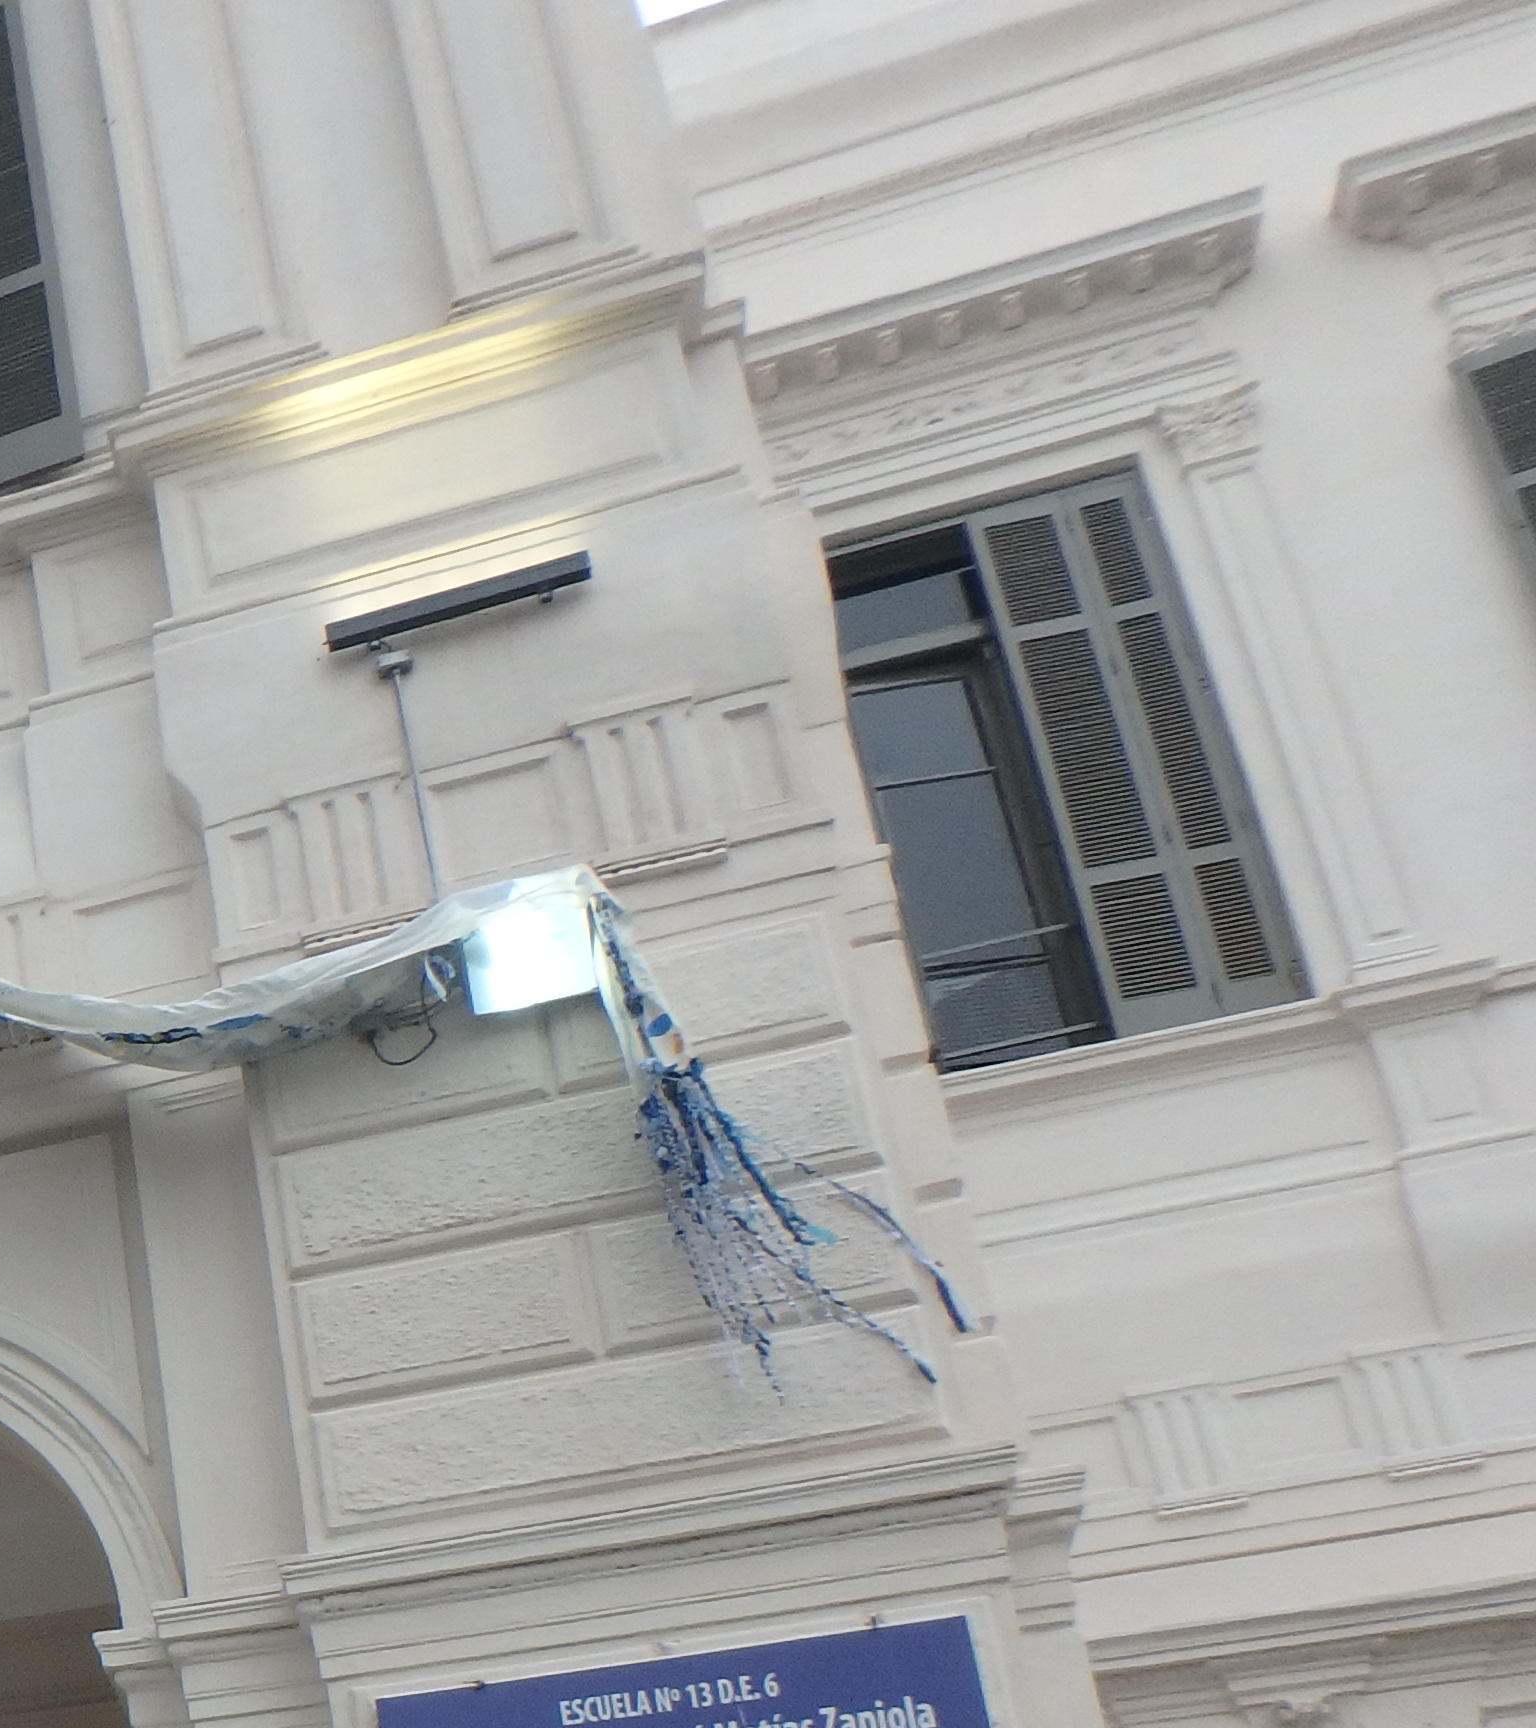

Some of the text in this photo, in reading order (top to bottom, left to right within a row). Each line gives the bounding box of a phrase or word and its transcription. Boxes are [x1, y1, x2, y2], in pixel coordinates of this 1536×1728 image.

[559, 1690, 652, 1726] ESCUELA
[684, 1682, 714, 1709] 13
[716, 1675, 762, 1705] D.E.
[763, 1672, 780, 1698] 6
